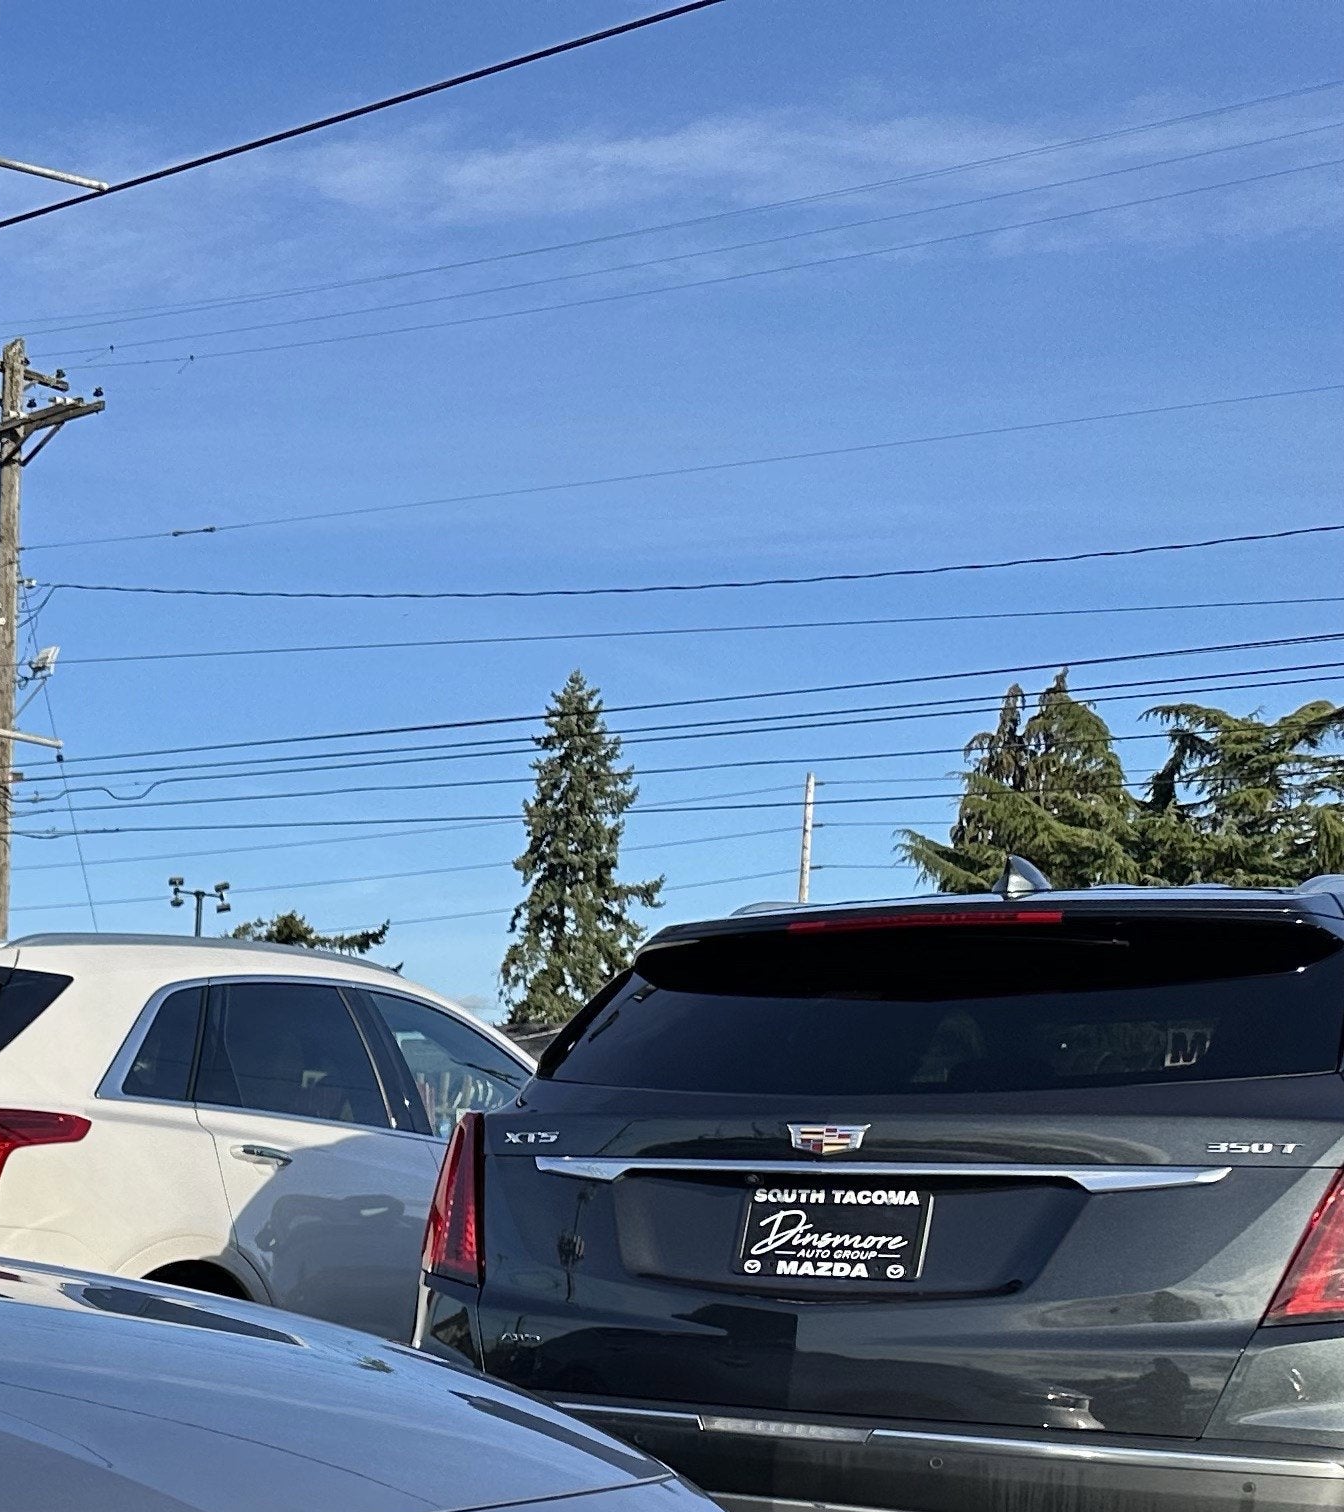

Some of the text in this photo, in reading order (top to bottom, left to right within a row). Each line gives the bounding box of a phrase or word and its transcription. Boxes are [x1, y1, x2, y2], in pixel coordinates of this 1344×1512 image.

[754, 1188, 920, 1206] SOUTH TACOMA
[750, 1209, 909, 1255] Dinsmore
[796, 1248, 877, 1260] AUTO GROUP
[776, 1260, 869, 1278] MAZDA
